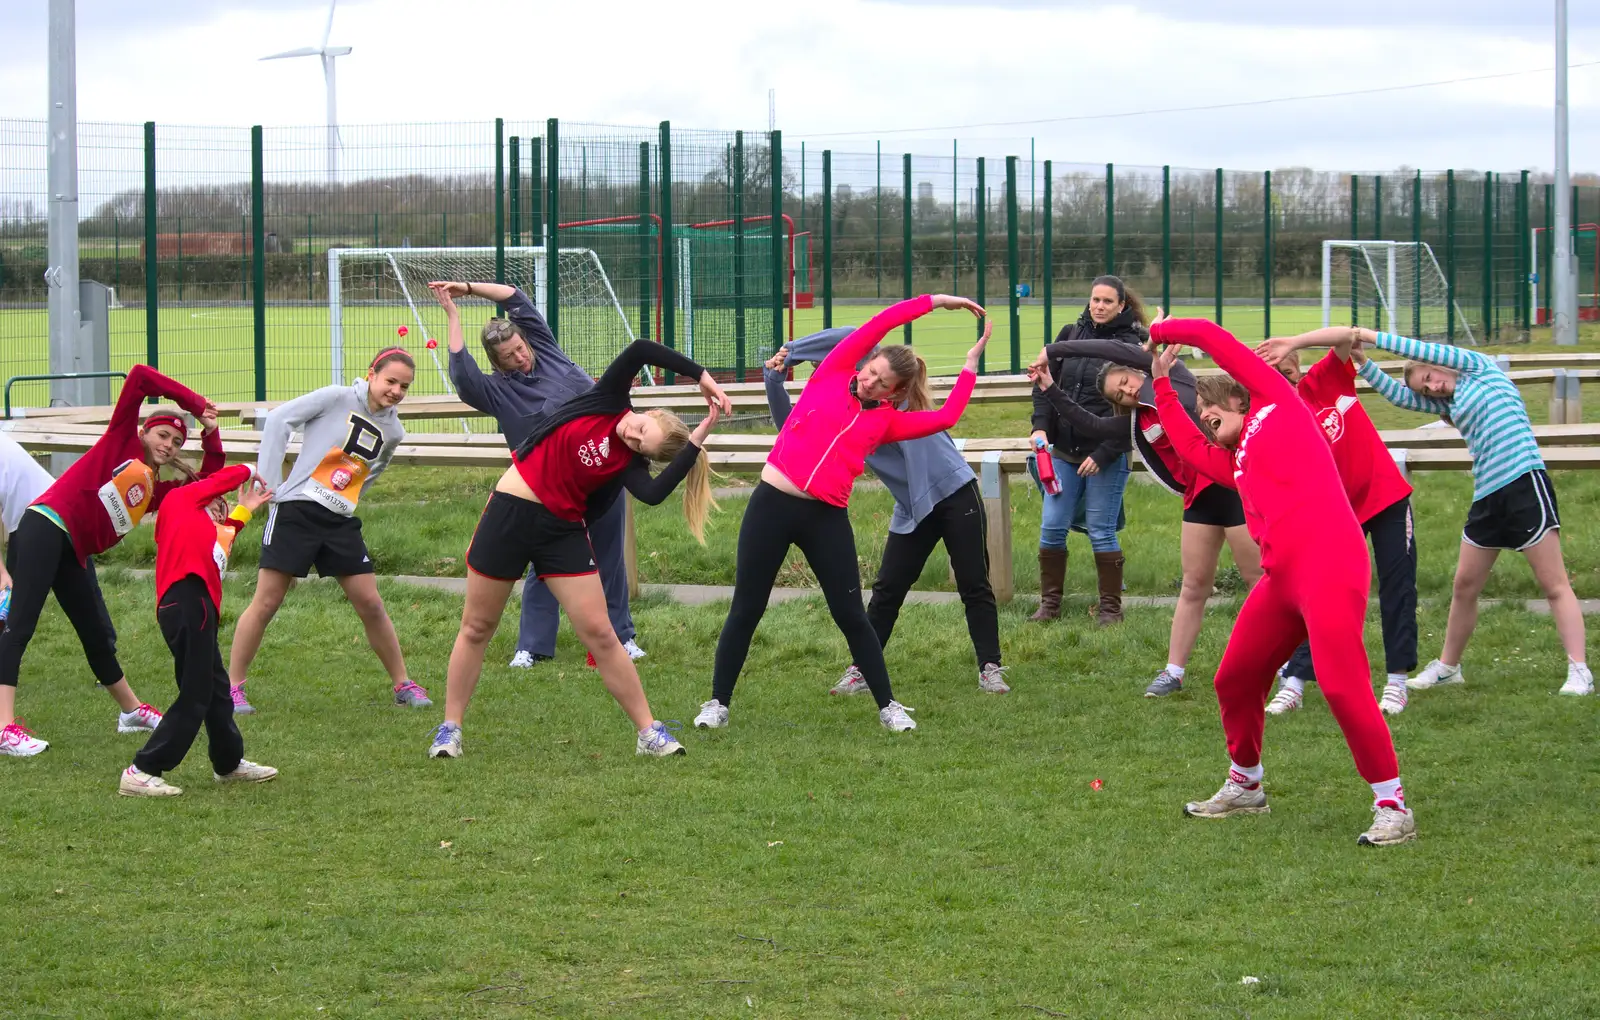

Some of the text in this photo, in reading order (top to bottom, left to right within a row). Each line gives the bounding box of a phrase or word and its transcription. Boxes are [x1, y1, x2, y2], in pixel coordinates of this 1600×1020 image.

[343, 411, 385, 462] P
[587, 439, 603, 467] TEAM GB
[107, 492, 127, 527] 3A0813789
[314, 486, 348, 511] 3A0813790
